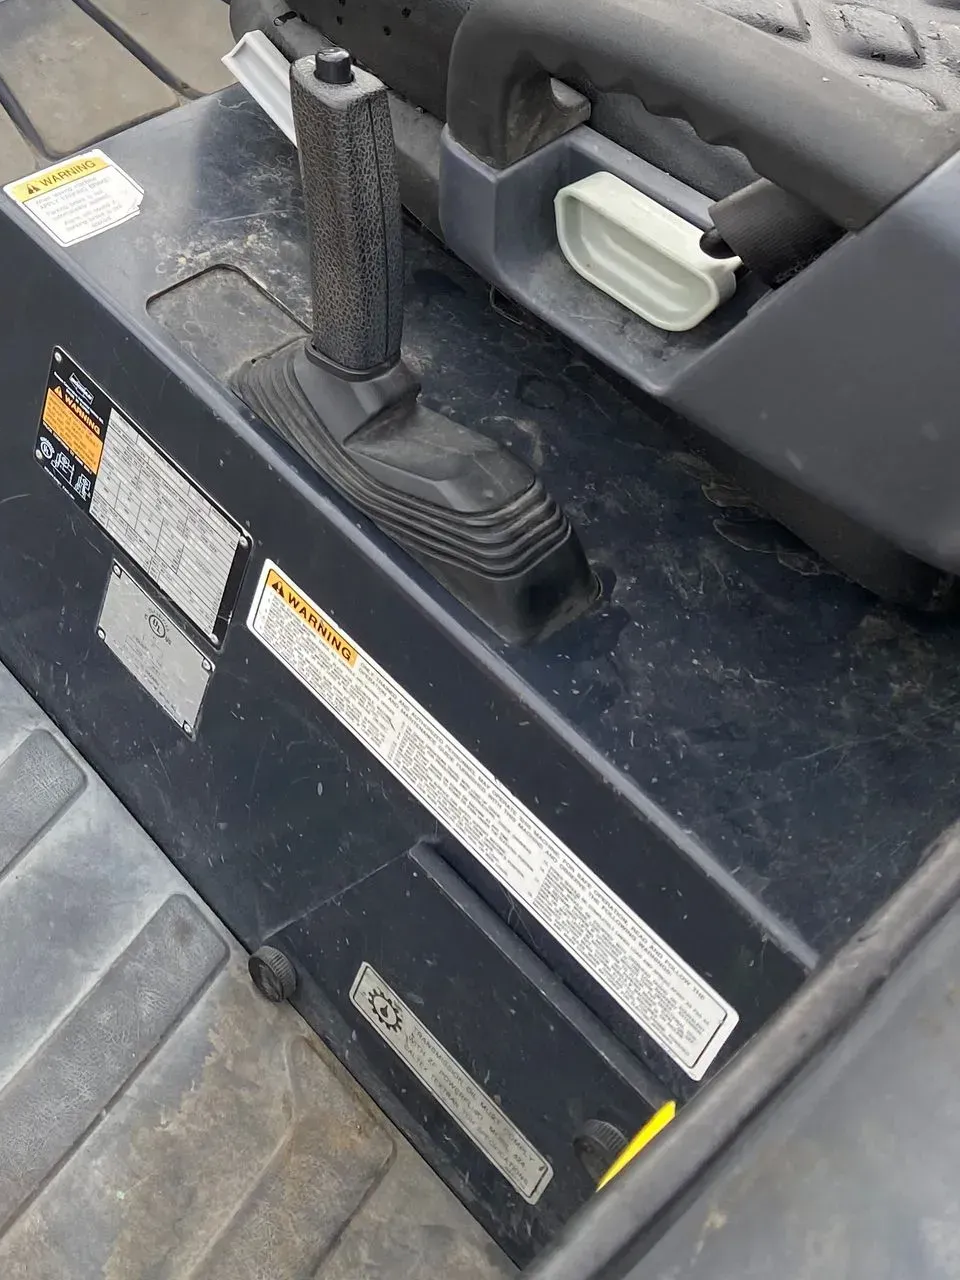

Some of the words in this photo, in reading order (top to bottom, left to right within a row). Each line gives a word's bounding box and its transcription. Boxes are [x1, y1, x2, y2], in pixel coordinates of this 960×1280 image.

[40, 160, 96, 187] WARNING
[63, 390, 101, 437] WARNING
[286, 591, 352, 662] WARNING
